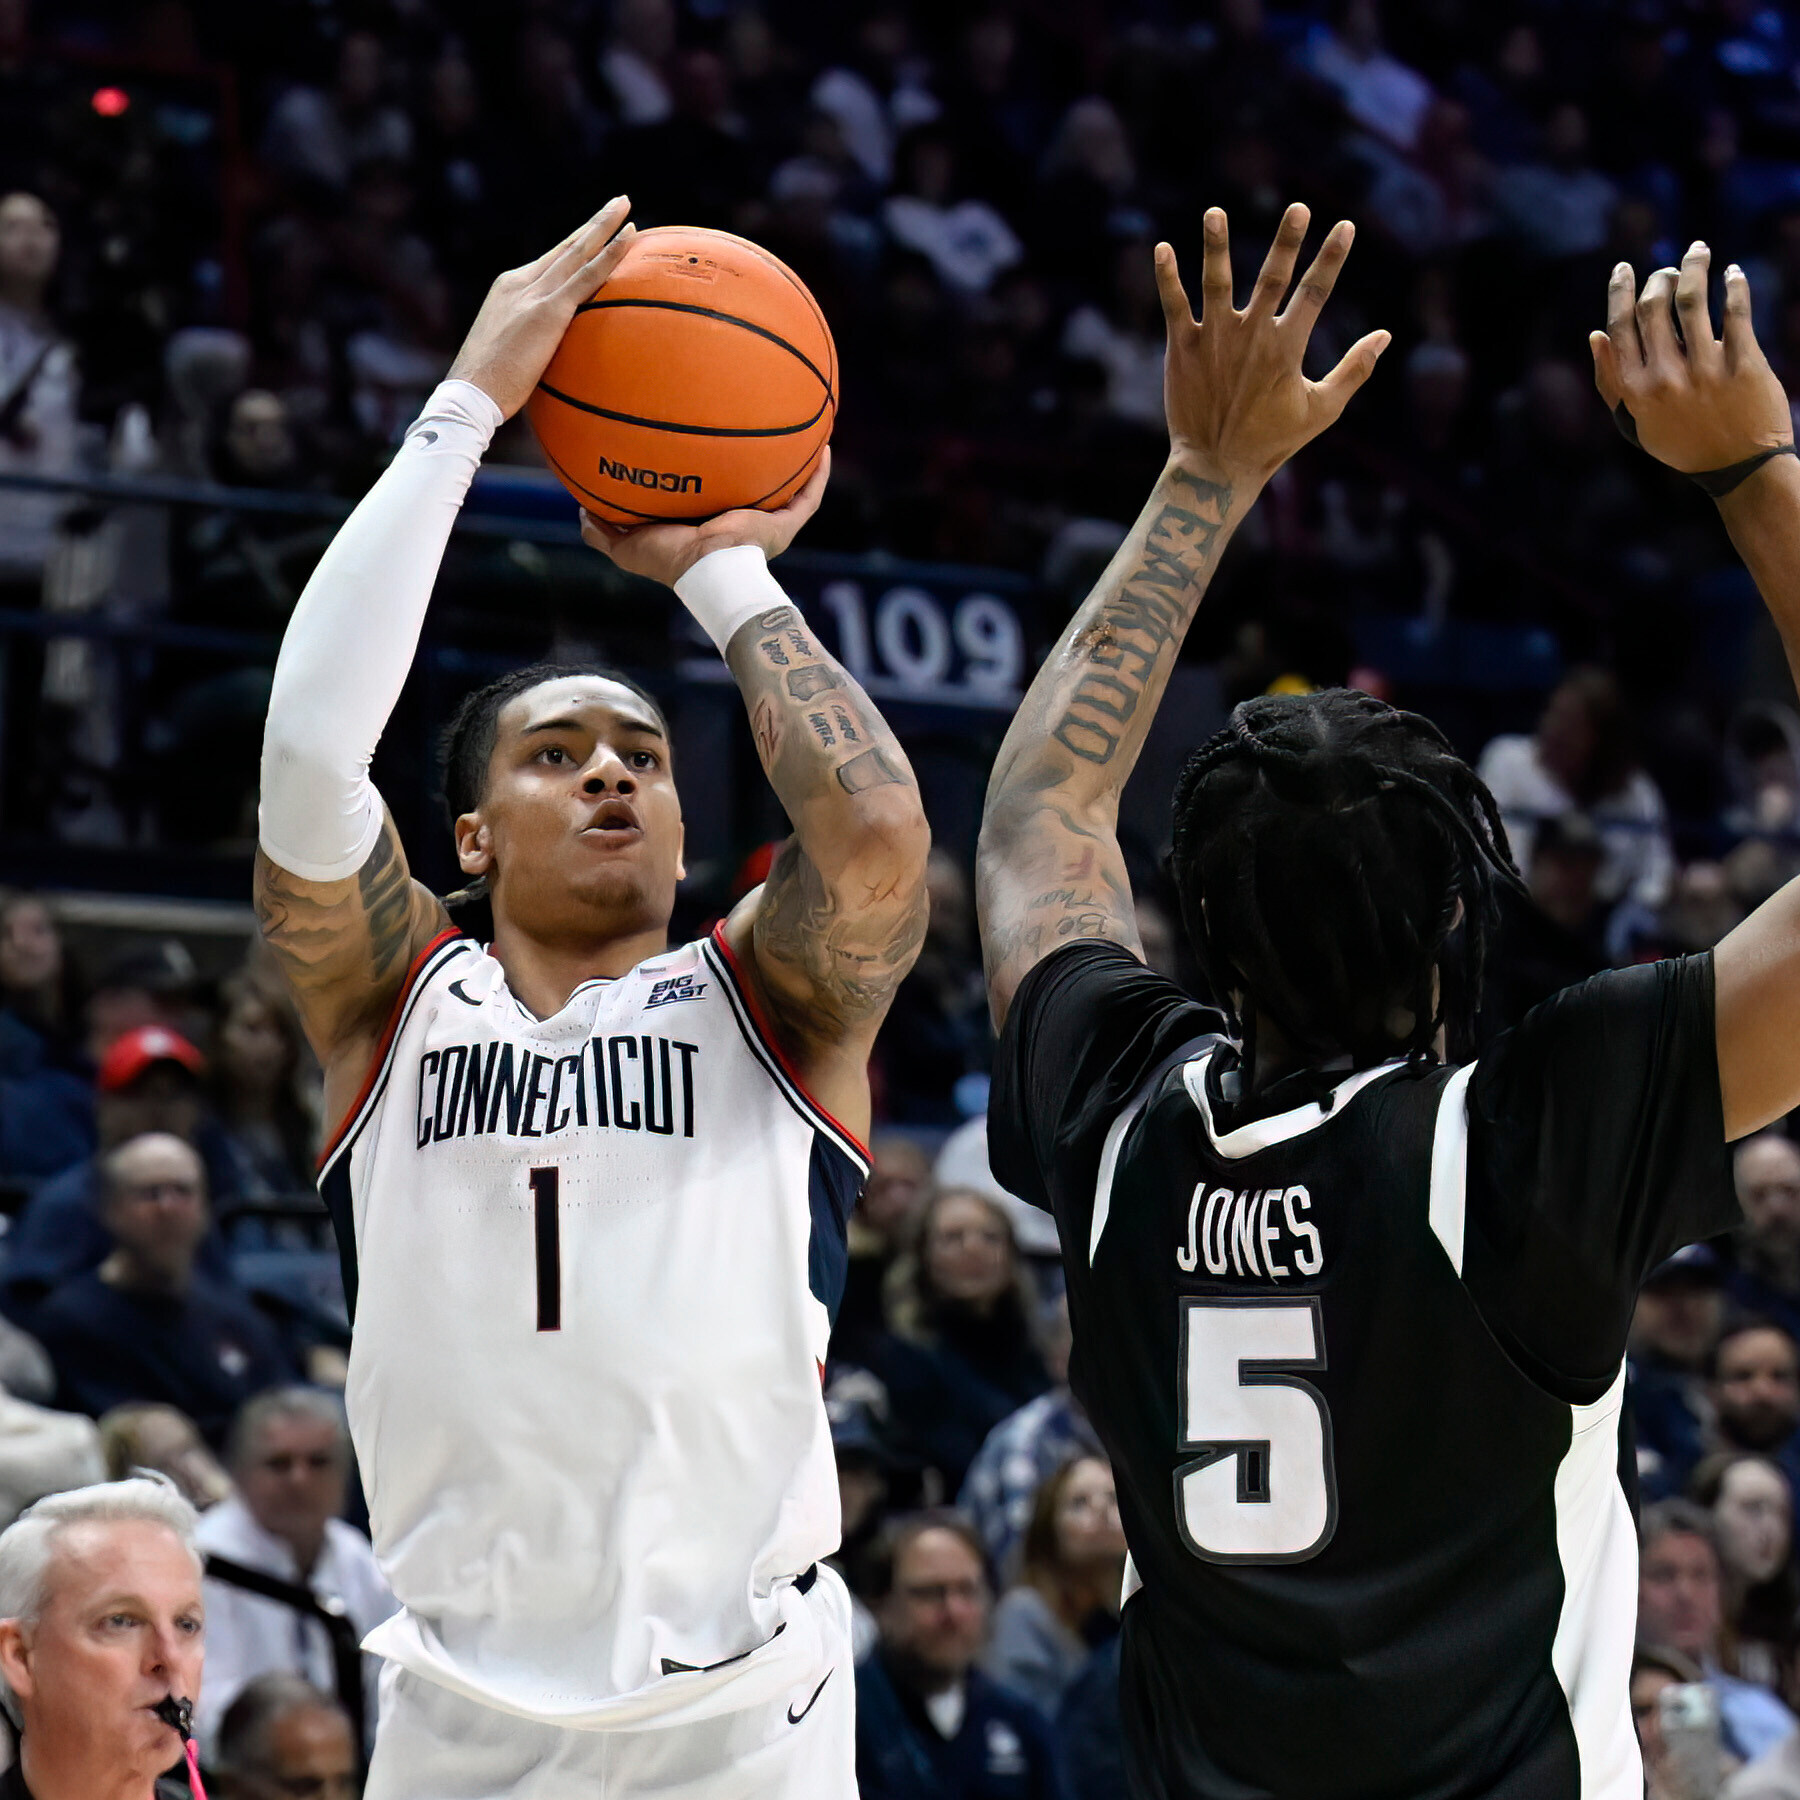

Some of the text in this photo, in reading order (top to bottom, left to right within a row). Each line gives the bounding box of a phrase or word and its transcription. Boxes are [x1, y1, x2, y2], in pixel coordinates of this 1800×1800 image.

[599, 456, 703, 495] UCONN
[822, 583, 1026, 695] 109
[647, 983, 709, 1005] EAST
[651, 974, 694, 994] BIG
[416, 1034, 700, 1150] CONNECTICUT
[528, 1166, 561, 1332] 1
[1176, 1181, 1324, 1279] JONES
[1173, 1294, 1339, 1566] 5
